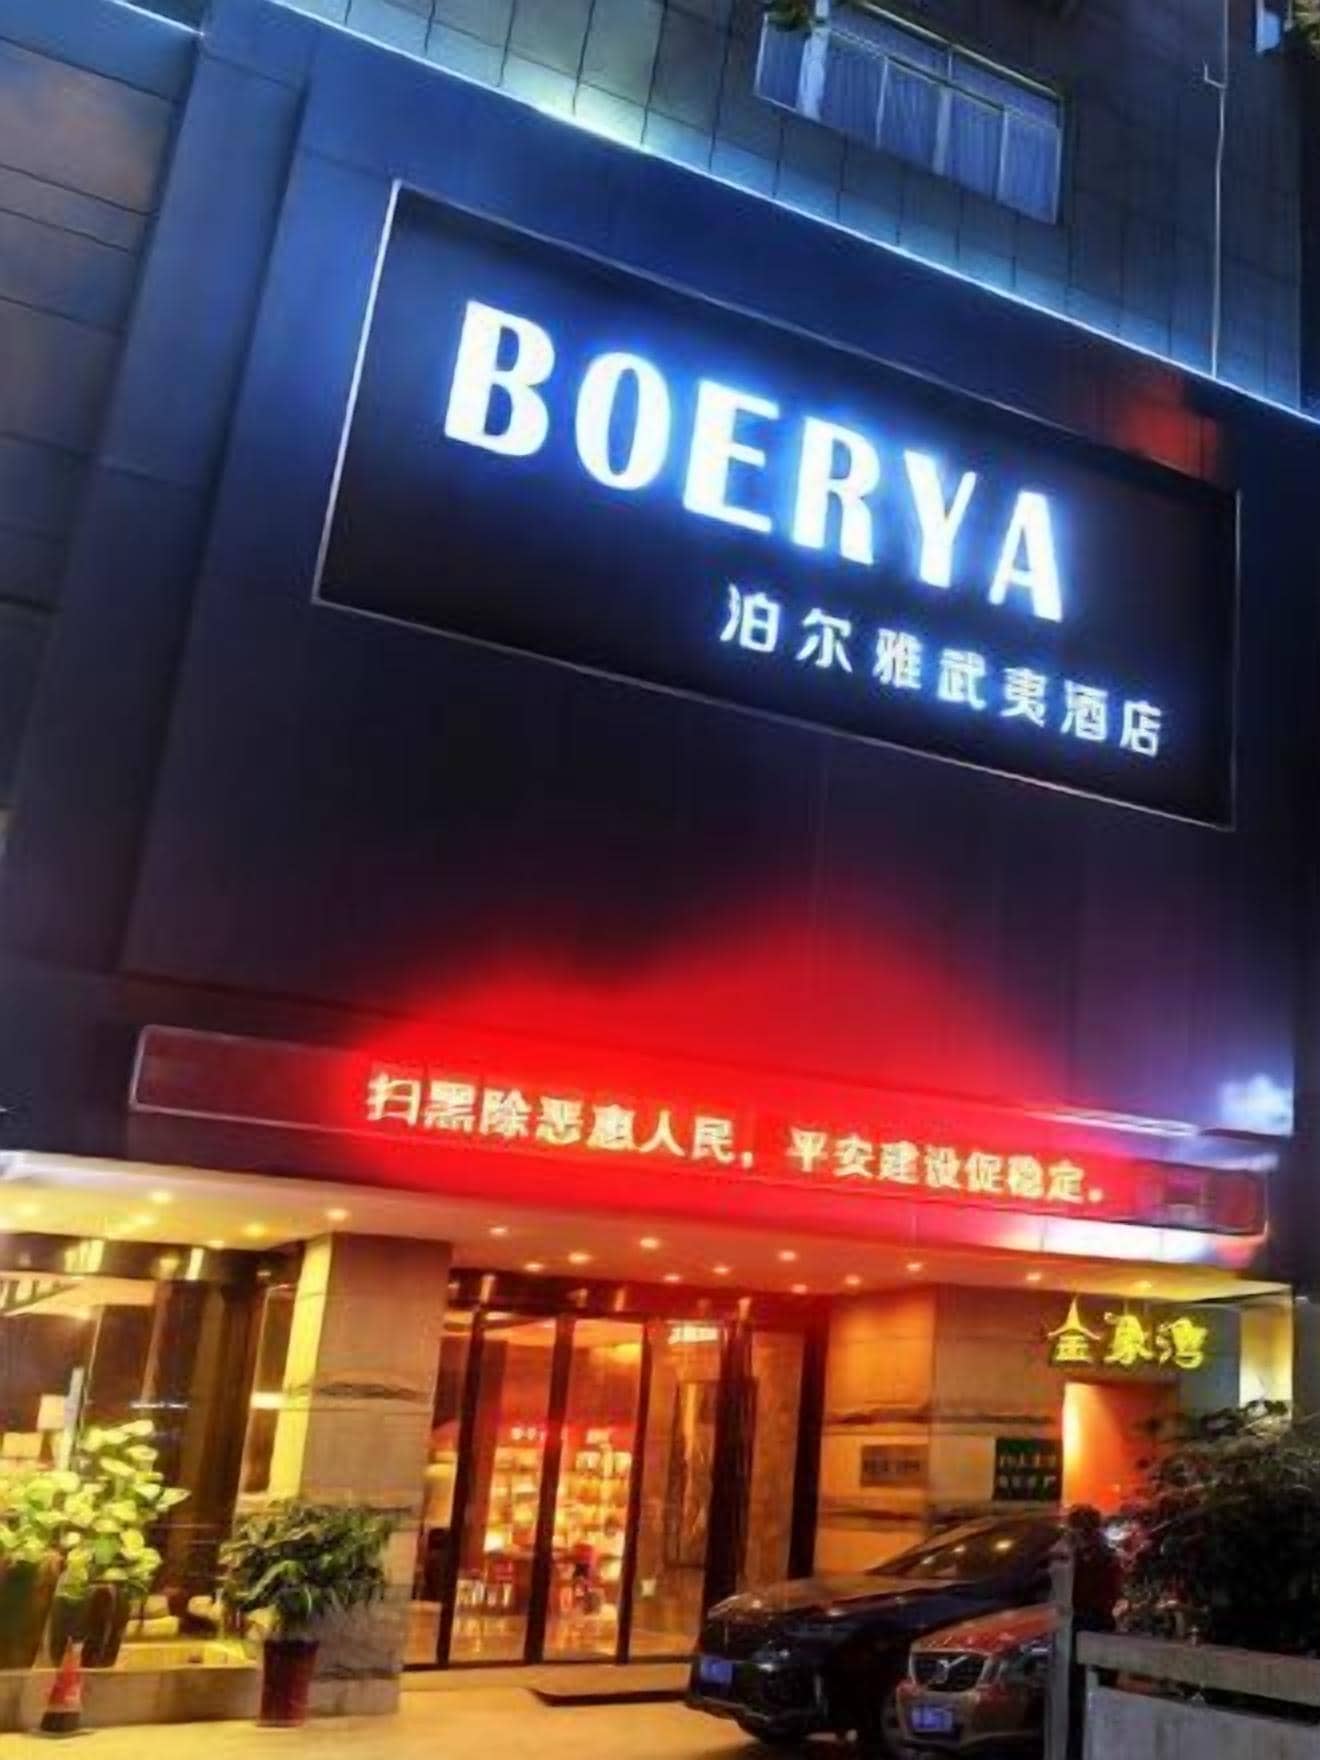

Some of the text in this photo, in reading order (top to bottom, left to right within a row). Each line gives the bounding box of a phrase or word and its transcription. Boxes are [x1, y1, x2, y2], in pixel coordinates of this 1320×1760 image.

[444, 300, 1064, 623] BOERYA
[719, 582, 1163, 758] 泊尔雅武夷酒店
